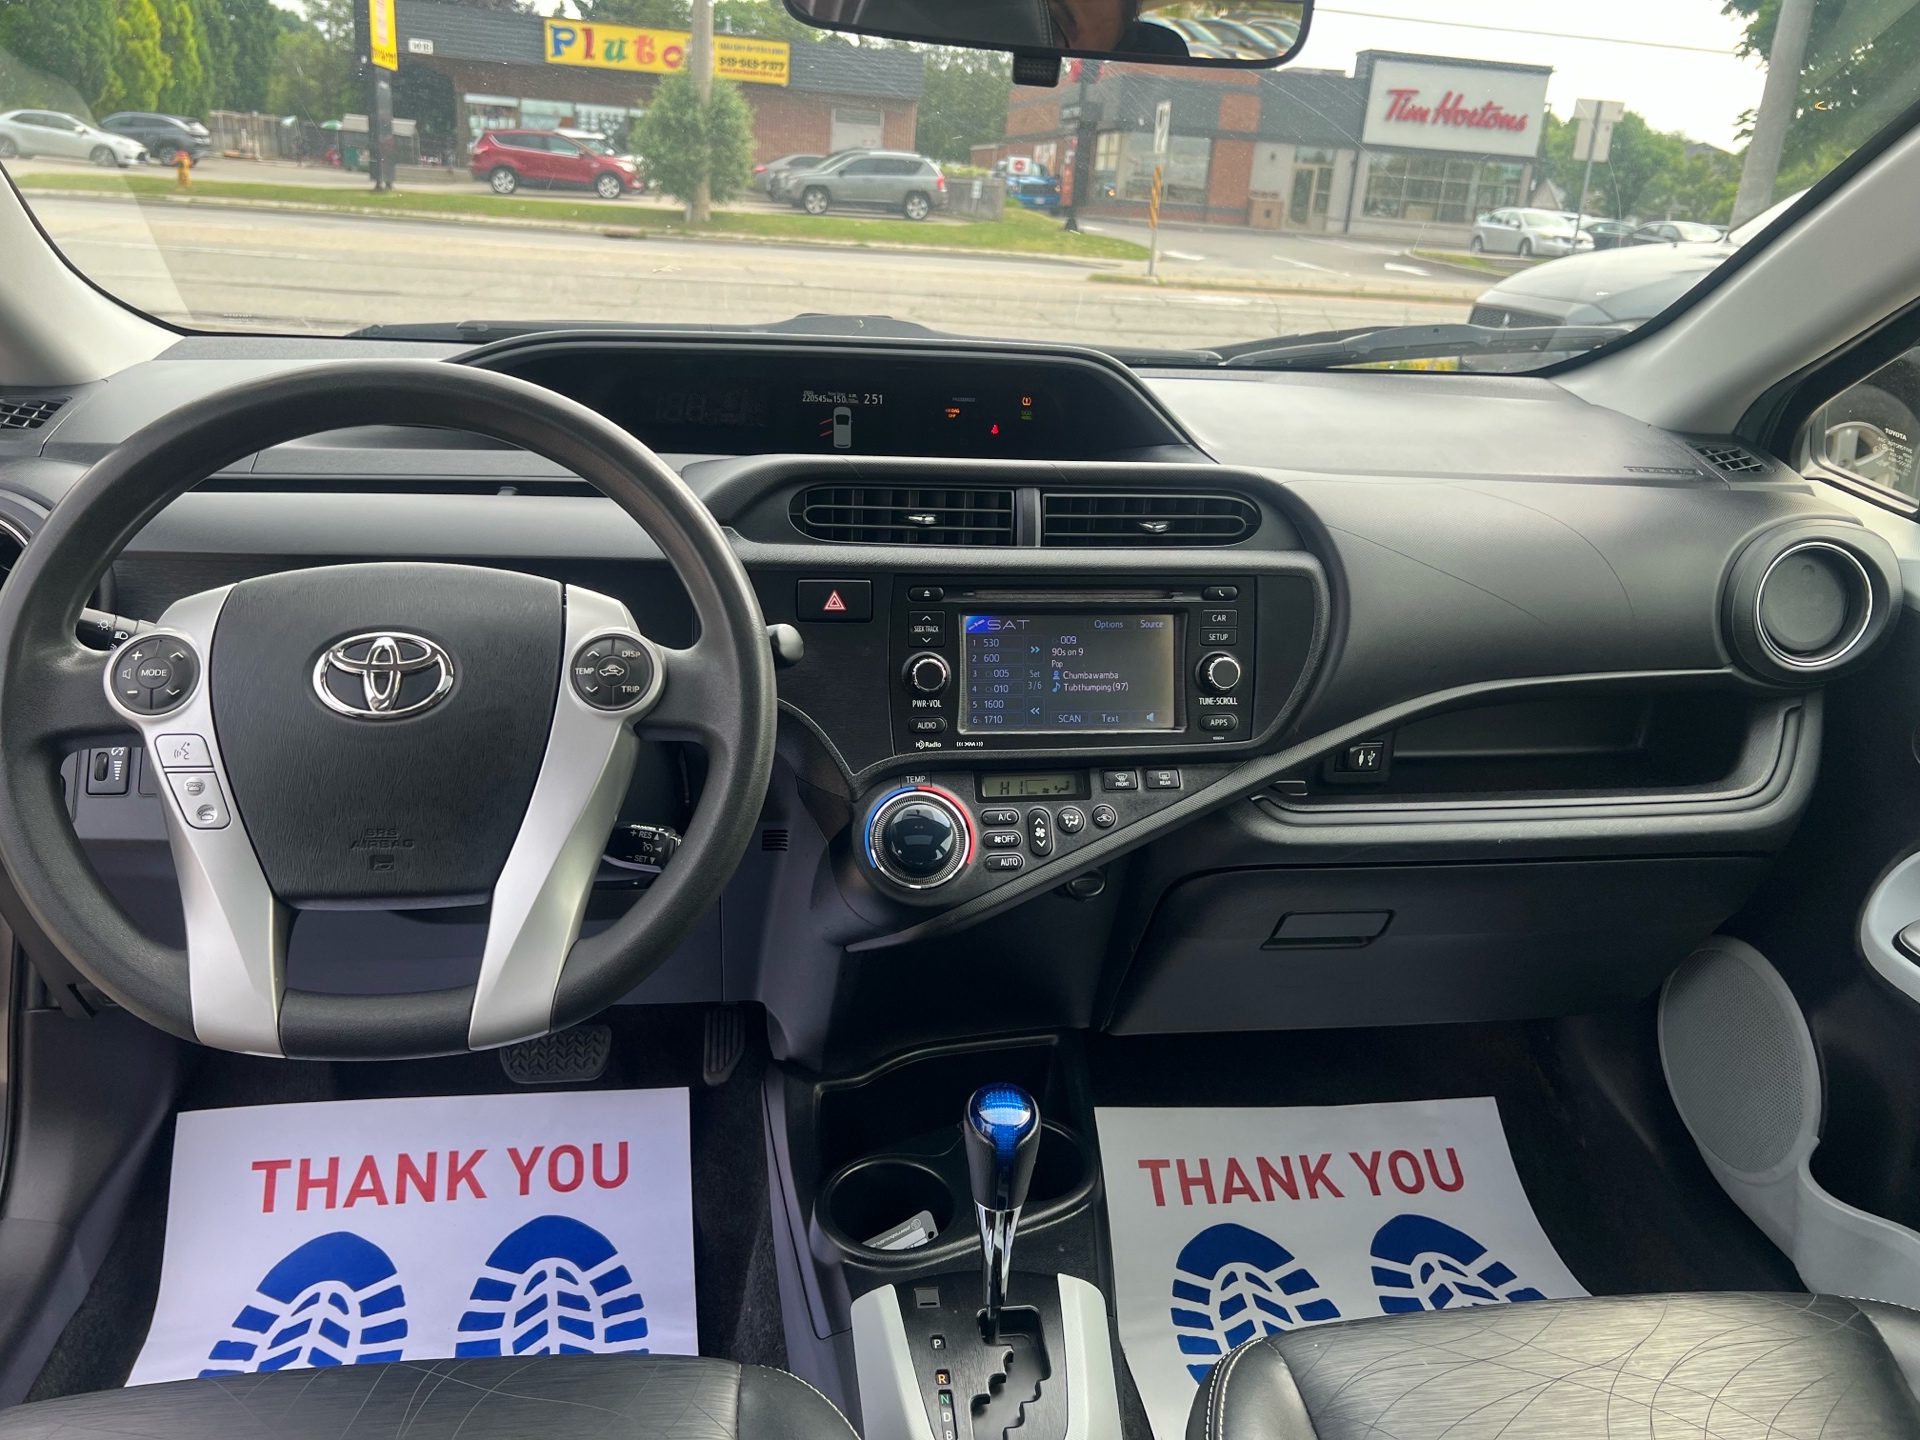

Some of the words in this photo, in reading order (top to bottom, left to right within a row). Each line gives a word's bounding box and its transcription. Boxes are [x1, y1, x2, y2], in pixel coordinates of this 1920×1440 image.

[1385, 88, 1430, 124] Tim
[1432, 90, 1528, 132] Hortons
[1885, 427, 1907, 441] TOYOTA
[1211, 614, 1227, 622] CAR
[914, 625, 925, 633] SEEK
[925, 625, 939, 633] TRACK
[987, 619, 1031, 631] SAT
[1094, 619, 1124, 630] Options
[1140, 619, 1164, 629] Source
[1060, 635, 1077, 645] 009
[1208, 633, 1229, 641] SETUP
[983, 638, 1000, 648] 530
[621, 650, 641, 658] DISP
[1051, 647, 1067, 656] 90s
[1078, 647, 1084, 656] 9
[972, 654, 977, 663] 2
[983, 653, 1000, 663] 600
[1051, 660, 1064, 669] Pop
[141, 669, 167, 677] MODE
[575, 667, 595, 675] TEMP
[972, 669, 978, 678] 3
[993, 668, 1010, 678] 005
[1029, 669, 1041, 678] Set
[1063, 670, 1119, 680] Chumbawamba
[621, 685, 640, 693] TRIP
[972, 685, 977, 693] 4
[993, 684, 1009, 693] 010
[1028, 681, 1042, 691] 3/6
[1064, 683, 1112, 692] Tubthumping
[1112, 682, 1129, 692] (97)
[972, 700, 978, 709] 5
[984, 699, 1004, 709] 1600
[972, 716, 978, 724] 6
[984, 715, 1003, 724] 1710
[1058, 714, 1081, 723] SCAN
[1101, 713, 1119, 723] Text
[1210, 718, 1228, 727] APPS
[917, 721, 937, 729] AUDIO
[905, 775, 926, 784] TEMP
[998, 812, 1012, 822] A/C
[365, 828, 399, 838] SRS
[638, 830, 653, 840] RES
[1001, 835, 1016, 844] OFF
[349, 839, 415, 851] AIRBAG
[634, 854, 648, 863] SET
[1000, 857, 1018, 866] AUTO
[252, 1149, 487, 1213] THANK
[506, 1141, 629, 1196] YOU
[1138, 1153, 1345, 1207] THANK
[1348, 1147, 1464, 1196] YOU
[933, 1339, 942, 1349] P
[938, 1374, 947, 1384] R
[940, 1394, 949, 1404] N
[943, 1412, 951, 1422] D
[945, 1430, 953, 1440] B
